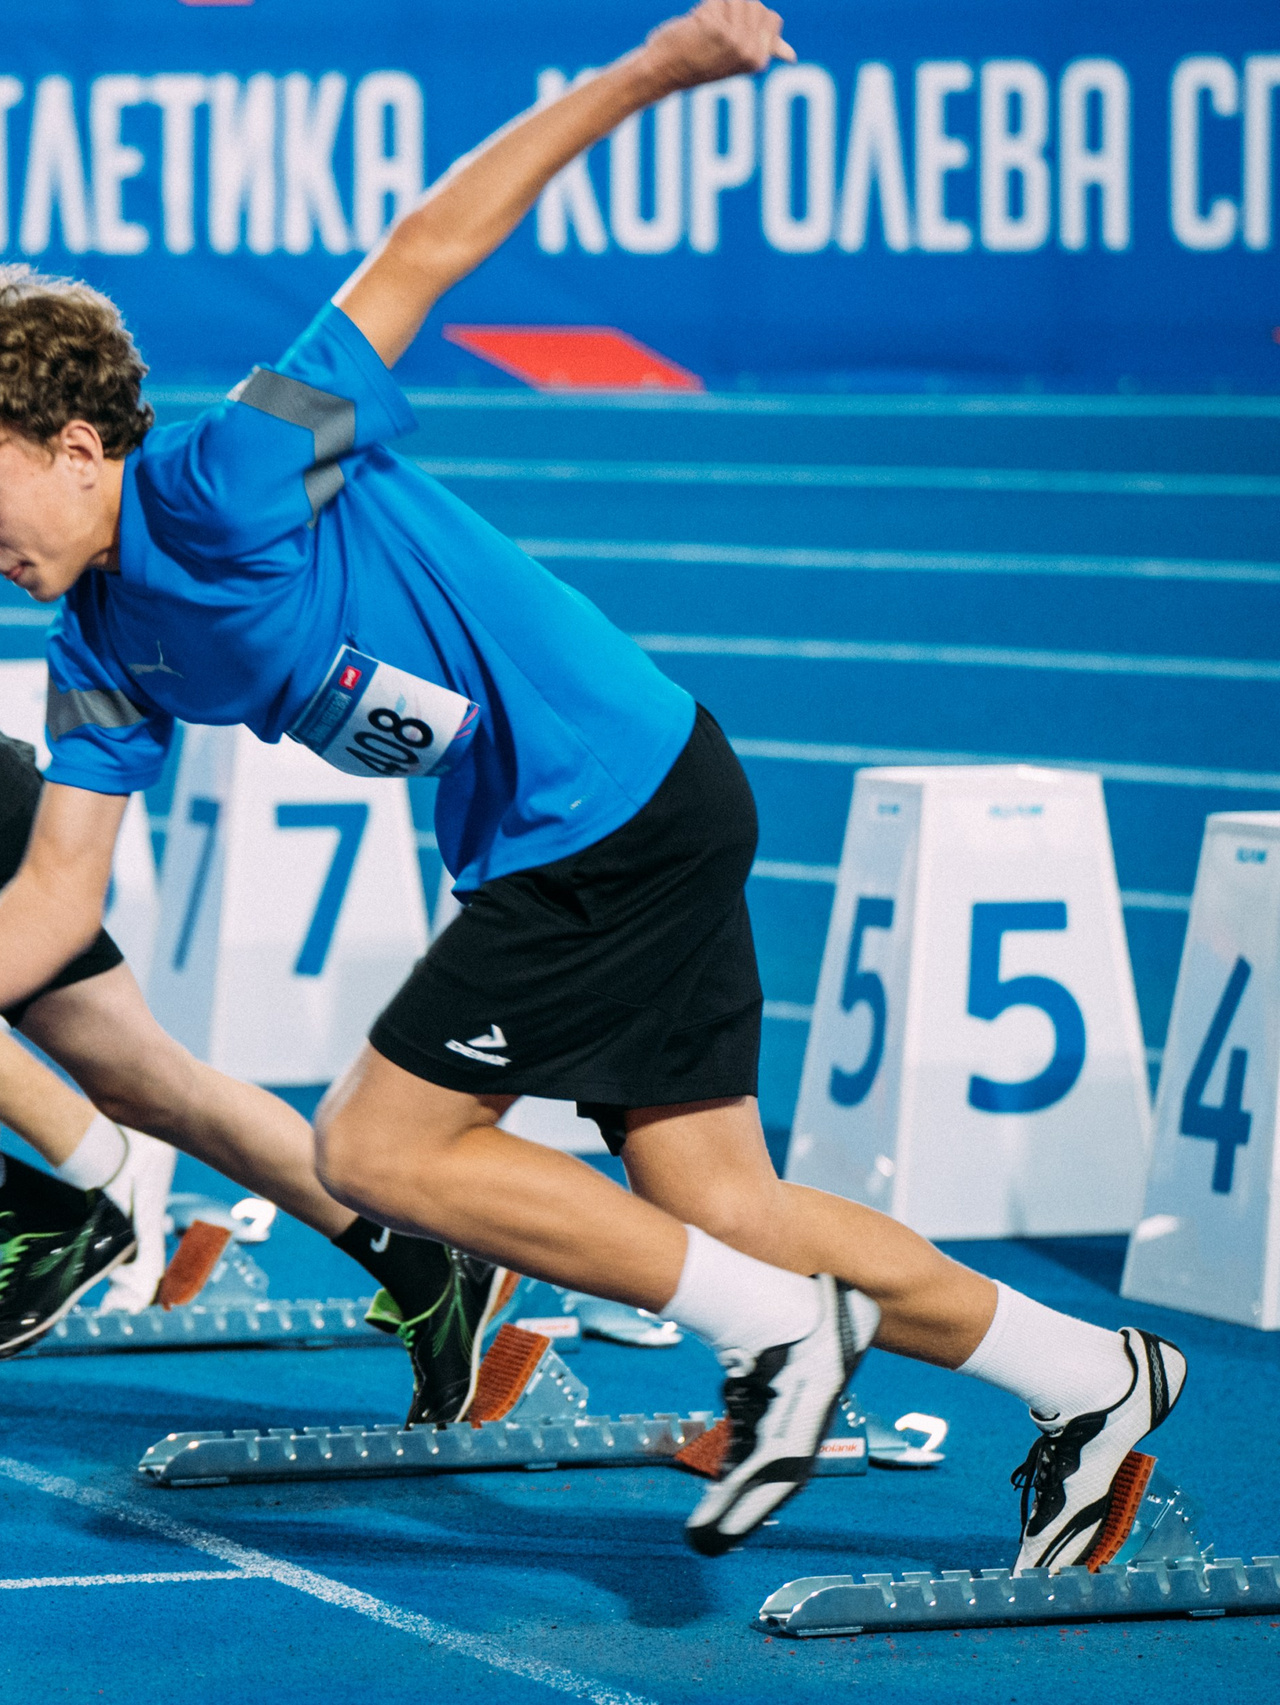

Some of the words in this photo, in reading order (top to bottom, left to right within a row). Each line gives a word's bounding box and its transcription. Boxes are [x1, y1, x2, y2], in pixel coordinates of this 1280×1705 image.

[345, 708, 434, 776] 408
[275, 803, 370, 977] 7
[829, 896, 895, 1108] 5
[967, 901, 1086, 1114] 5
[1180, 955, 1252, 1195] 4
